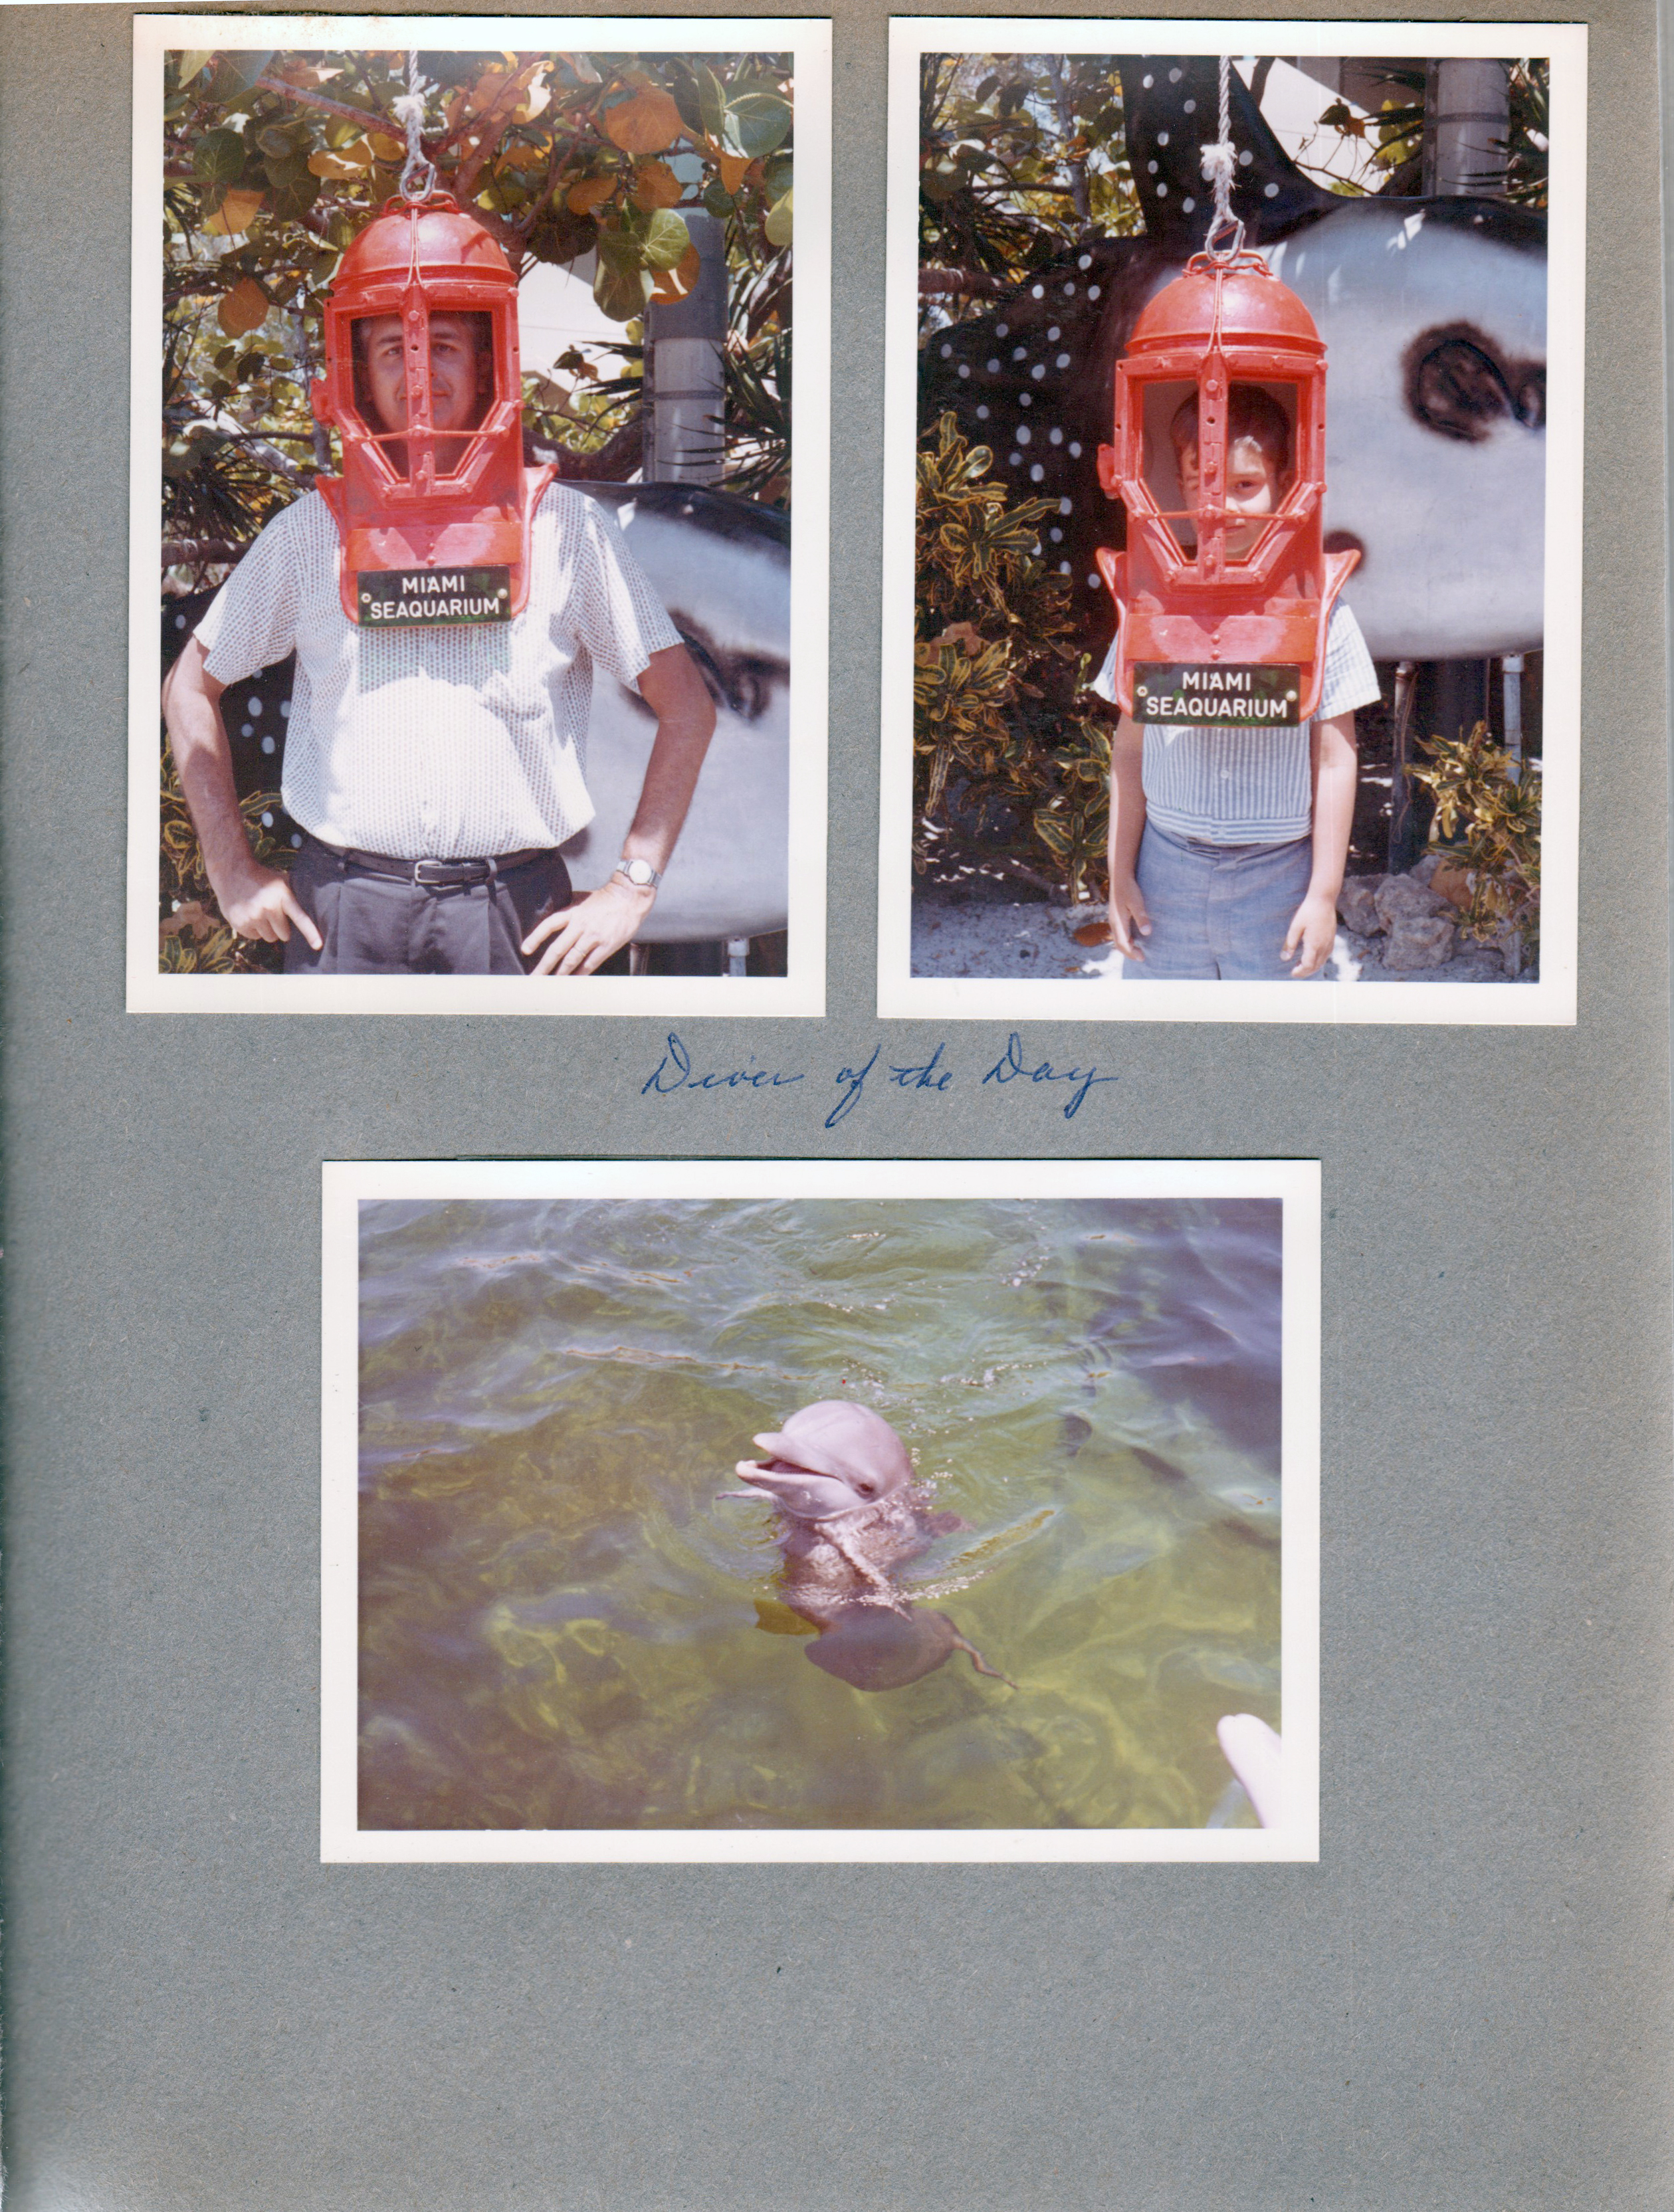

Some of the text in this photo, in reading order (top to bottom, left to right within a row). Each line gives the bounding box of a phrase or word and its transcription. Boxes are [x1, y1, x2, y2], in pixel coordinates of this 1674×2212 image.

[401, 575, 465, 594] MIAMI
[370, 597, 500, 619] SEAQUARIUM
[1182, 671, 1251, 691] MIAMI
[1146, 696, 1288, 718] SEAQUARIUM
[641, 1031, 1120, 1128] Diver of the Day
